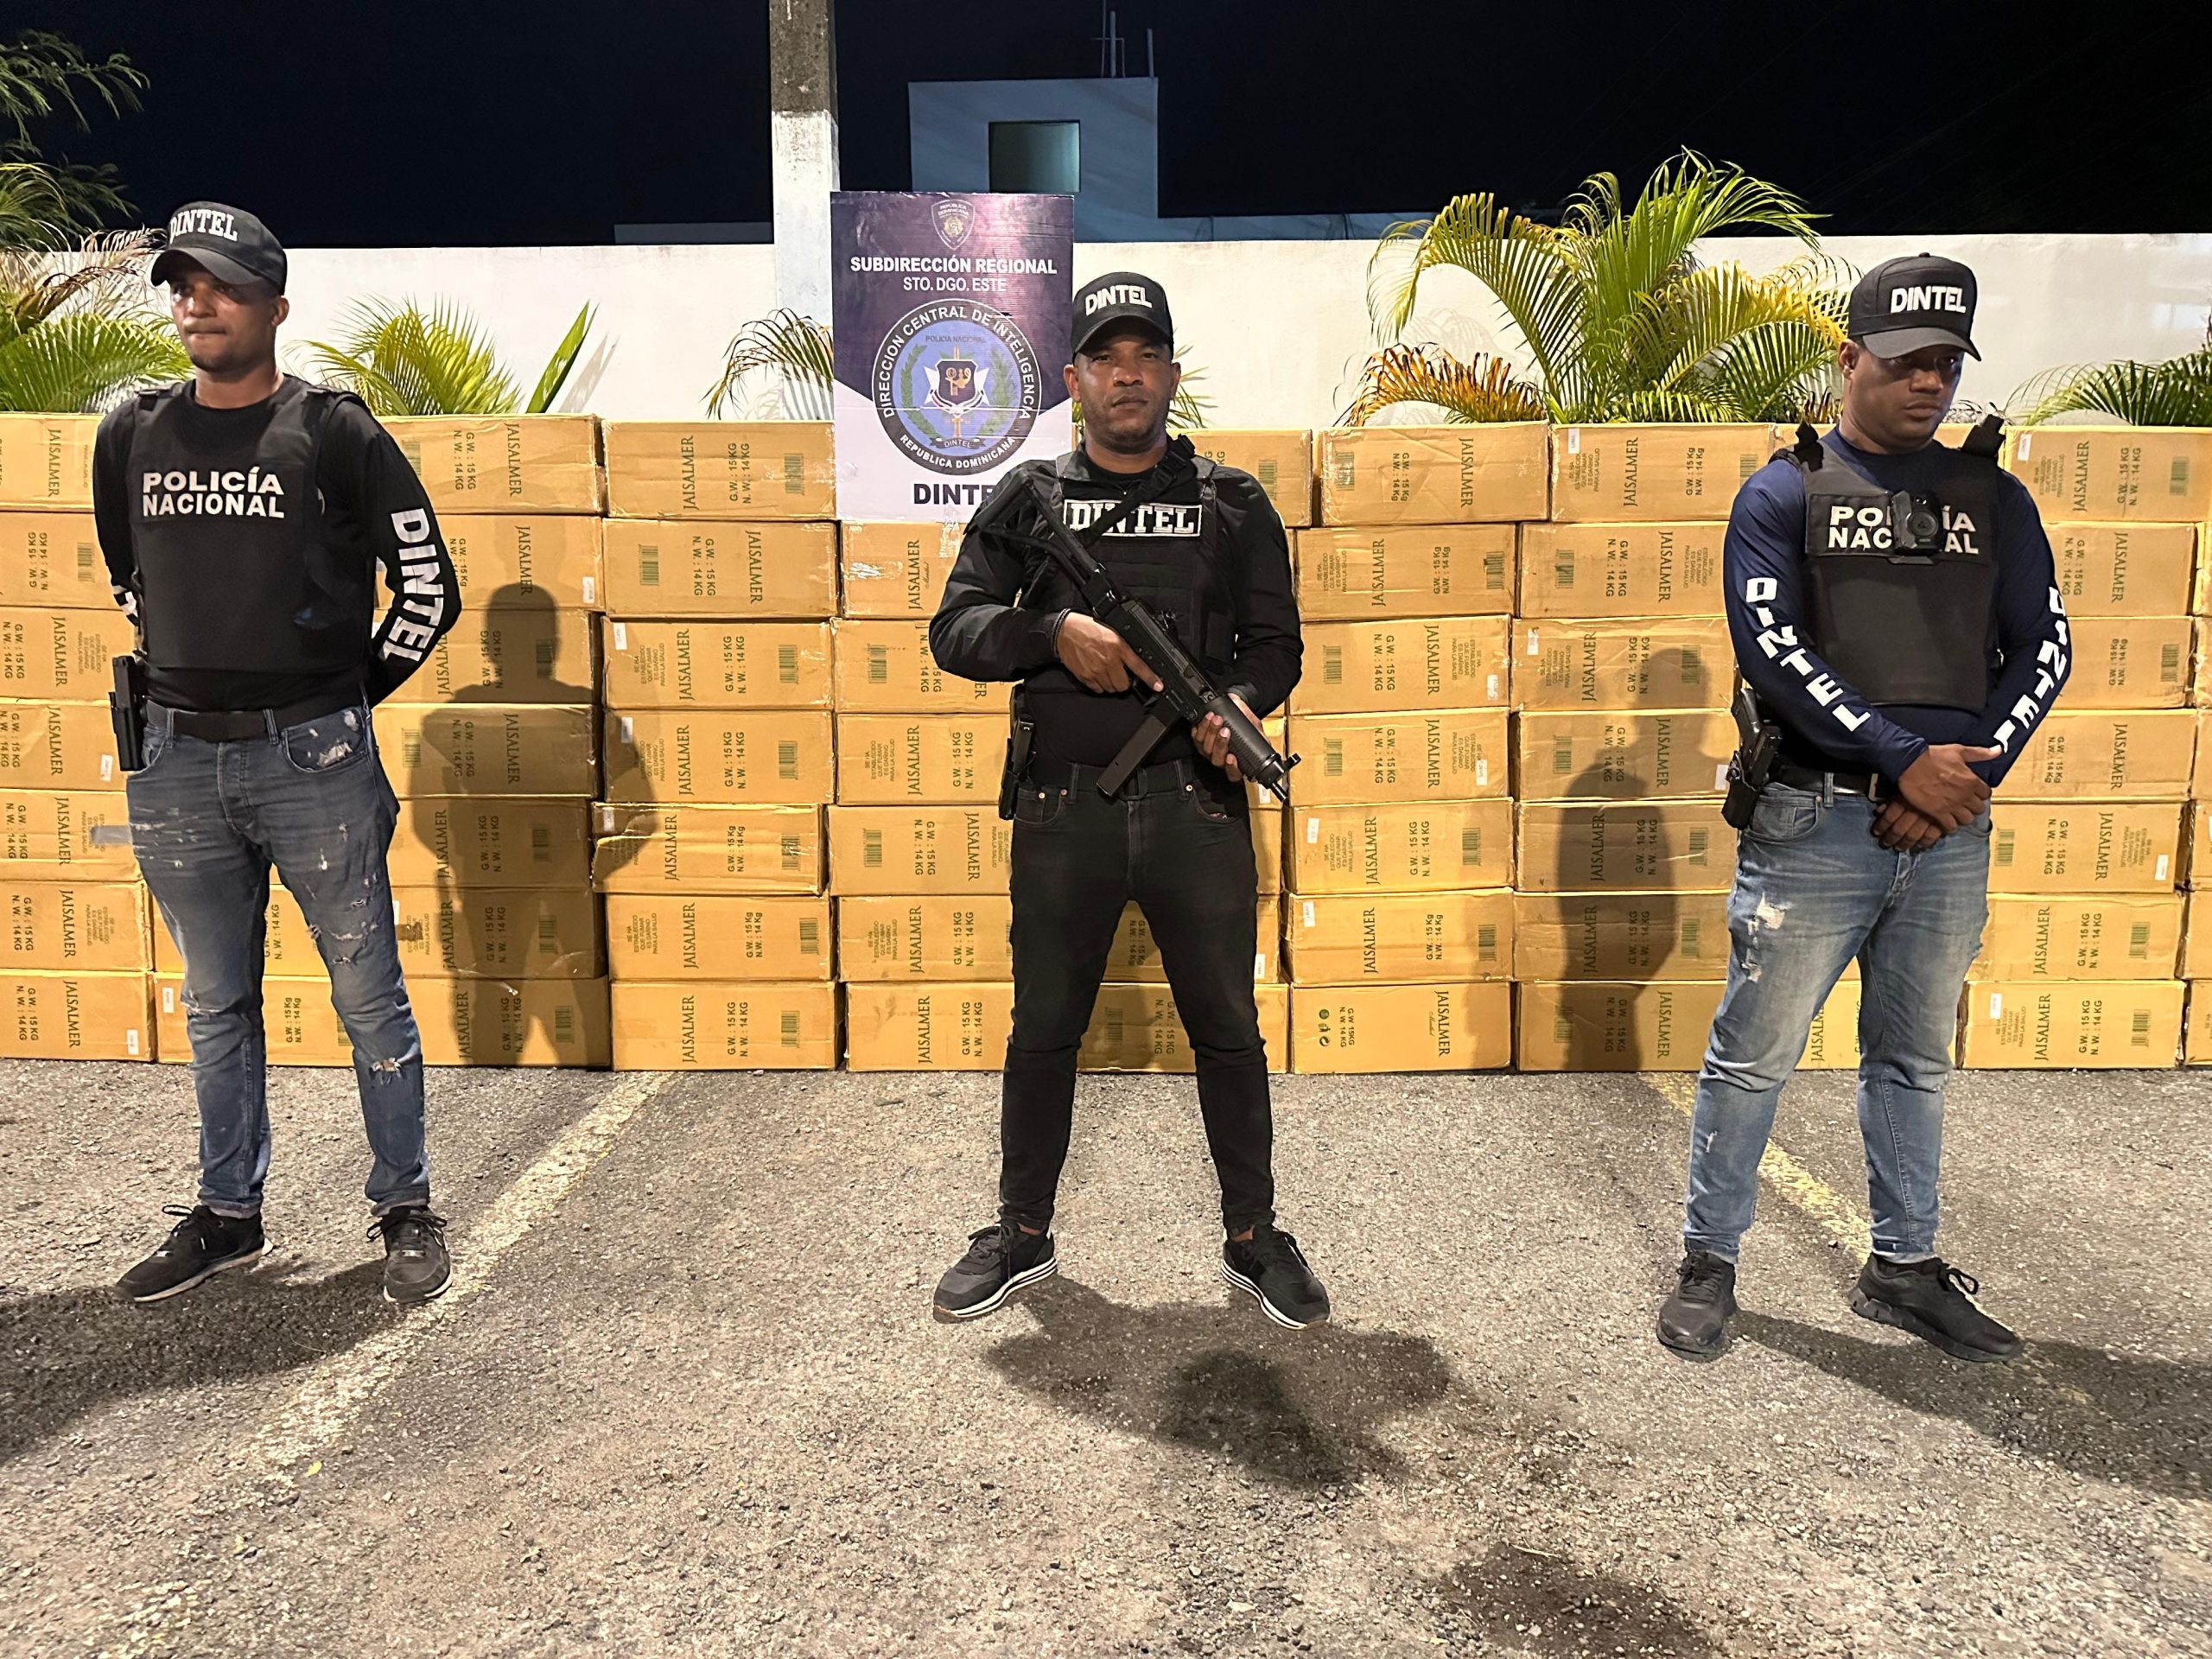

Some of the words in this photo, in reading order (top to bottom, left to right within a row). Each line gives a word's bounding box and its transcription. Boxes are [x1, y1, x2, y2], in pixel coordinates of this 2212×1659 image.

[169, 209, 238, 244] DINTEL
[850, 255, 971, 274] SUBDIRECCIÓN
[976, 258, 1058, 275] REGIONAL
[903, 276, 934, 292] STO.
[936, 276, 970, 293] DGO.
[972, 277, 1007, 292] ESTE
[1085, 284, 1153, 316] DINTEL
[1890, 285, 1967, 314] DINTEL
[879, 334, 905, 418] DIRECCION
[903, 306, 968, 336] CENTRAL
[971, 308, 992, 327] DE
[993, 322, 1036, 420] INTELIGENCIA
[48, 429, 61, 497] JAISALMER
[467, 462, 476, 473] 15
[505, 422, 522, 497] JAISALMER
[681, 435, 699, 511] JAISALMER
[728, 443, 737, 457] KG
[728, 460, 737, 471] 15
[899, 434, 953, 468] REPUBLICA
[956, 436, 1015, 468] DOMINICANA
[944, 440, 972, 448] DINTEL
[1459, 438, 1473, 507] JAISALMER
[1624, 437, 1637, 506] JAISALMER
[1686, 461, 1694, 471] 15
[1688, 448, 1696, 460] Kg
[2073, 441, 2088, 512] JAISALMER
[143, 467, 284, 495] POLICÍA
[143, 493, 285, 518] NACIONAL
[467, 476, 477, 490] KG
[514, 526, 534, 595] JAISALMER
[707, 568, 715, 578] 15
[746, 531, 762, 604] JAISALMER
[1372, 539, 1386, 606] JAISALMER
[1659, 531, 1673, 602] JAISALMER
[1827, 527, 1980, 555] NACAL
[2112, 532, 2128, 602] JAISALMER
[383, 507, 445, 663] DINTEL
[707, 582, 716, 596] KG
[908, 540, 924, 609] JAISALMER
[1618, 570, 1627, 582] 15
[1618, 583, 1627, 597] KG
[52, 617, 67, 686] JAISALMER
[677, 629, 694, 700] JAISALMER
[1386, 664, 1395, 675] 15
[1425, 626, 1440, 696] JAISALMER
[1458, 644, 1464, 652] ES
[1582, 630, 1597, 702] JAISALMER
[1745, 577, 1872, 733] DINTEL
[1386, 677, 1395, 691] KG
[47, 704, 62, 775] JAISALMER
[503, 714, 520, 784] JAISALMER
[677, 726, 694, 795] JAISALMER
[907, 726, 922, 795] JAISALMER
[1426, 720, 1440, 788] JAISALMER
[1655, 717, 1672, 788] JAISALMER
[2111, 724, 2127, 790] JAISALMER
[55, 798, 71, 866] JAISALMER
[435, 810, 451, 879] JAISALMER
[665, 815, 679, 880] JAISALMER
[926, 849, 936, 860] 15
[965, 813, 980, 881] JAISALMER
[1365, 817, 1379, 884] JAISALMER
[1408, 822, 1418, 835] KG
[1408, 836, 1418, 847] 15
[1589, 811, 1606, 881] JAISALMER
[2095, 813, 2113, 880] JAISALMER
[927, 862, 936, 876] KG
[60, 890, 76, 957] JAISALMER
[441, 899, 456, 970] JAISALMER
[683, 903, 698, 969] JAISALMER
[886, 946, 892, 955] ES
[910, 906, 924, 973] JAISALMER
[953, 912, 963, 925] KG
[953, 927, 962, 937] 15
[1363, 908, 1378, 973] JAISALMER
[1582, 906, 1599, 975] JAISALMER
[2033, 906, 2050, 975] JAISALMER
[63, 981, 80, 1047] JAISALMER
[455, 989, 472, 1058] JAISALMER
[683, 995, 696, 1063] JAISALMER
[727, 1002, 736, 1015] KG
[727, 1017, 736, 1027] 15
[918, 996, 932, 1064] JAISALMER
[1433, 991, 1450, 1056] JAISALMER
[1657, 991, 1672, 1058] JAISALMER
[2035, 995, 2050, 1060] JAISALMER
[2081, 1015, 2089, 1027] 15
[2082, 1001, 2090, 1014] KG
